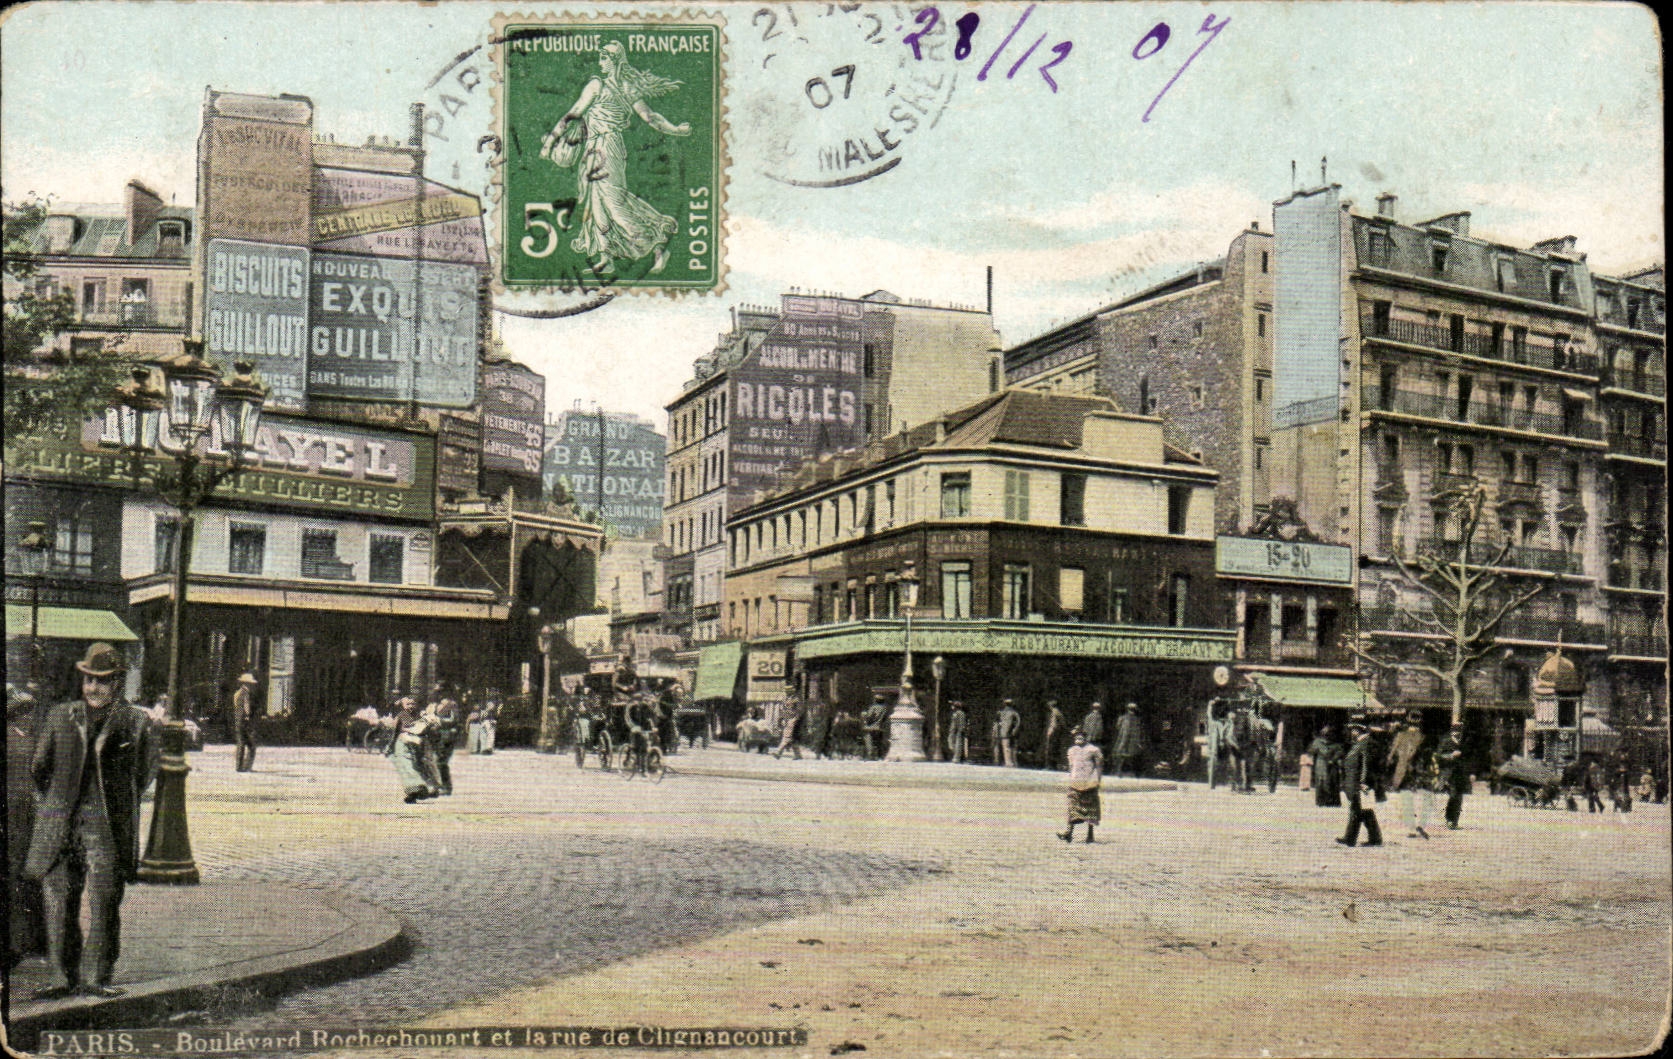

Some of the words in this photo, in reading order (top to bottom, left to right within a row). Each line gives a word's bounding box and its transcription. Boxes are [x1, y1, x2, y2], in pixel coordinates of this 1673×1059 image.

[628, 34, 708, 55] FRANÇAISE
[805, 63, 856, 109] 07
[377, 235, 401, 248] RUE
[687, 186, 710, 272] POSTES
[213, 252, 305, 298] BISCUITS
[208, 311, 306, 358] GUILLOUT
[311, 326, 468, 367] GUILLOUT
[568, 419, 628, 440] GRAND
[552, 444, 657, 469] BAZAR
[1010, 634, 1086, 653] RESTAURANT
[757, 661, 783, 675] 20
